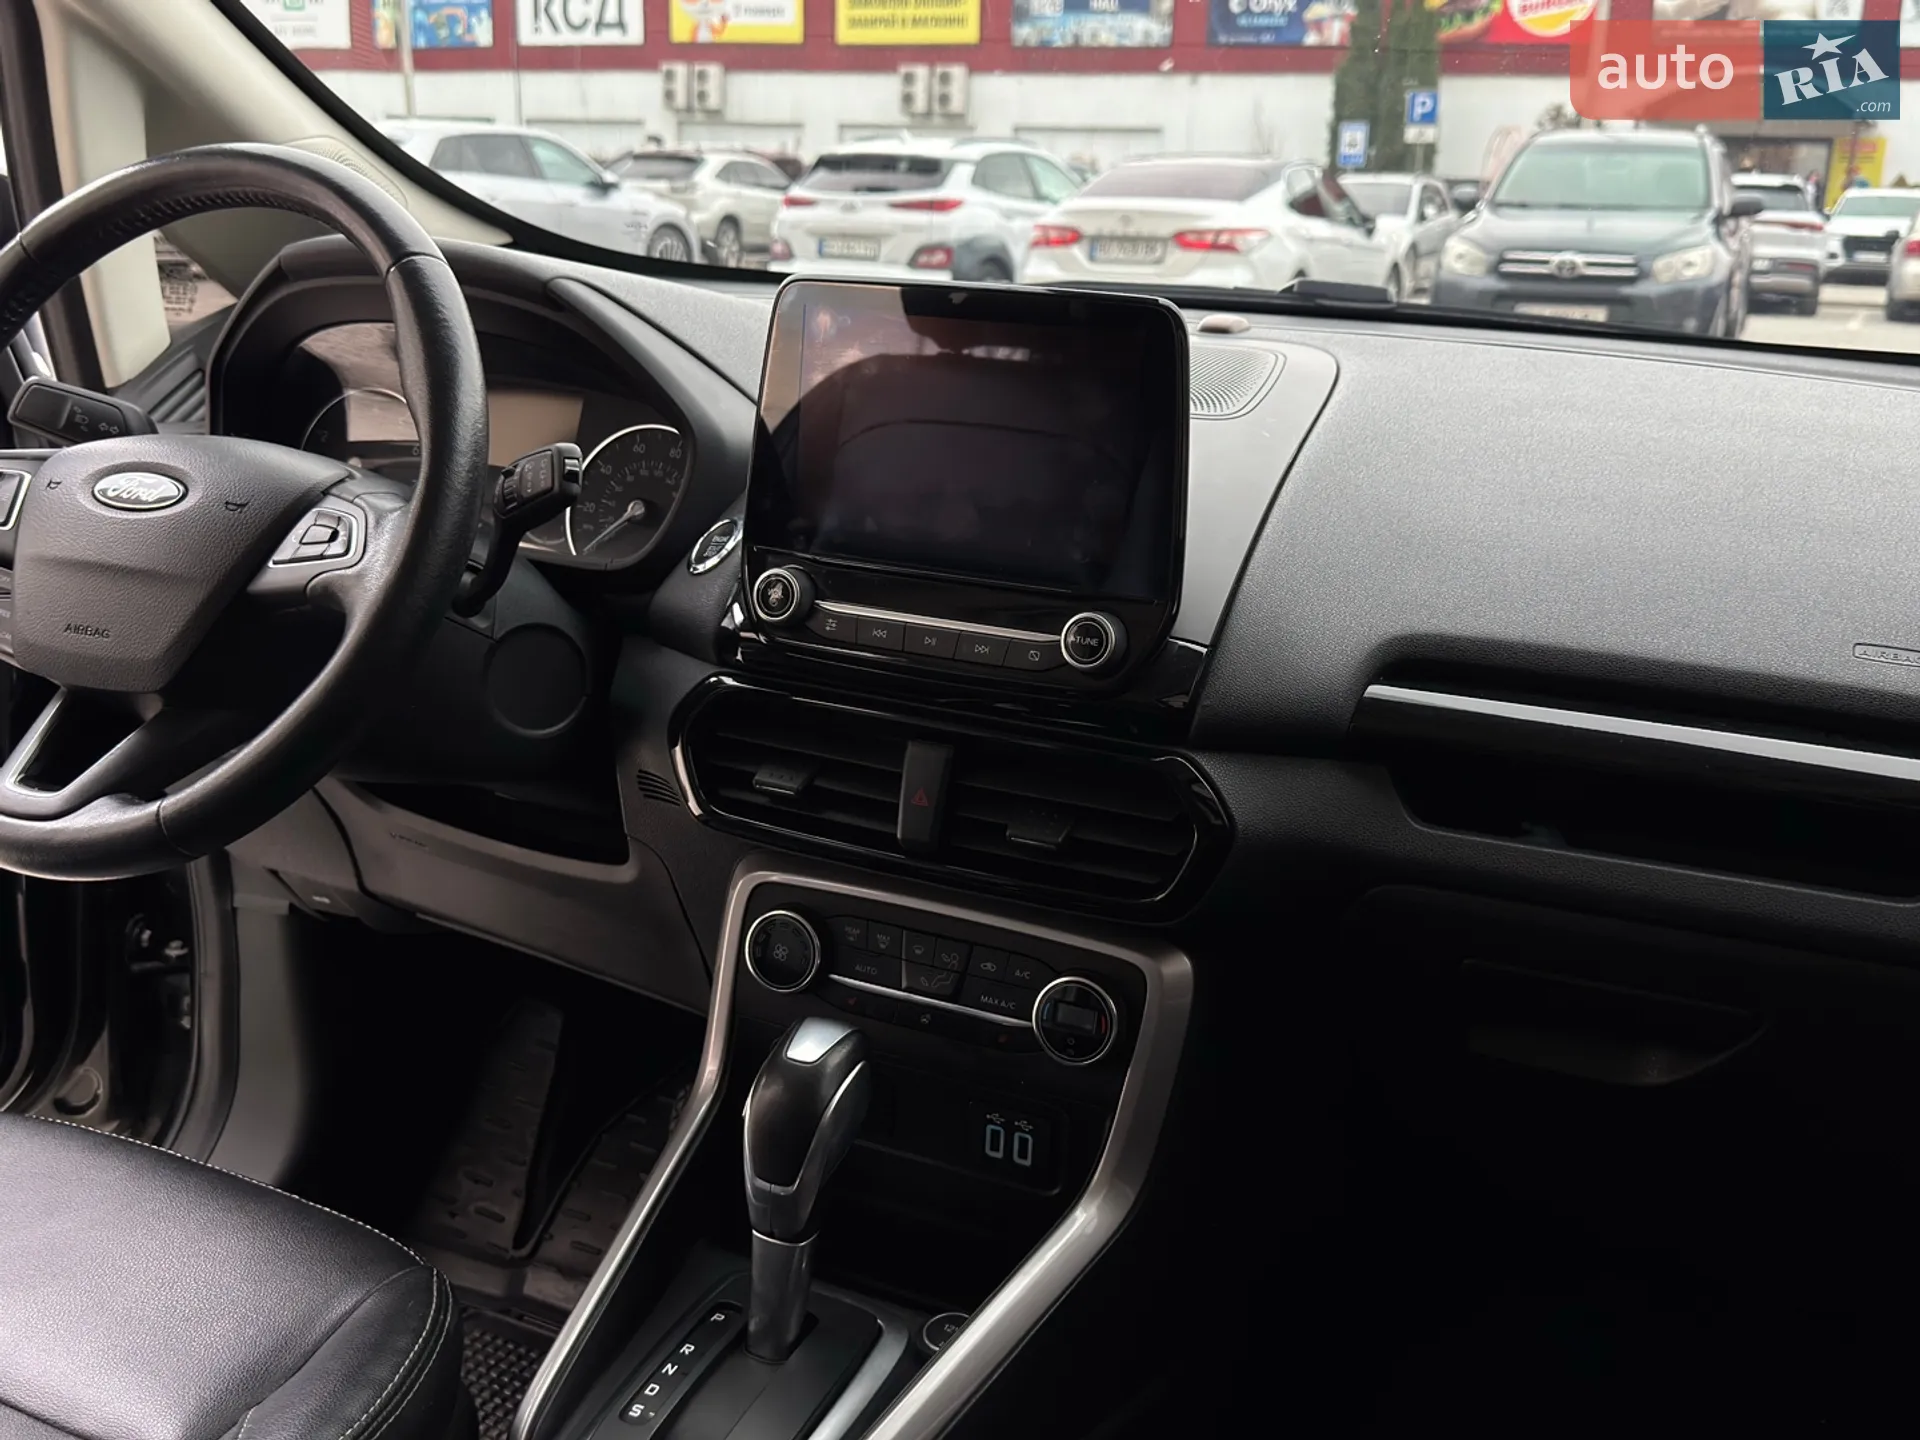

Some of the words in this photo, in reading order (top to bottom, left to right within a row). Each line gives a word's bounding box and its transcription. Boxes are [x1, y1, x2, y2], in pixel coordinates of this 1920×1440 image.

[1412, 93, 1434, 122] P
[107, 477, 166, 502] Ford
[63, 623, 110, 639] AIRBAG
[1075, 635, 1099, 647] TUNE
[854, 964, 878, 975] AUTO
[1014, 968, 1031, 980] A/C
[980, 994, 999, 1005] MAX
[710, 1312, 725, 1322] P
[679, 1343, 695, 1355] R
[661, 1362, 679, 1376] N
[643, 1382, 660, 1396] D
[627, 1403, 646, 1418] S
